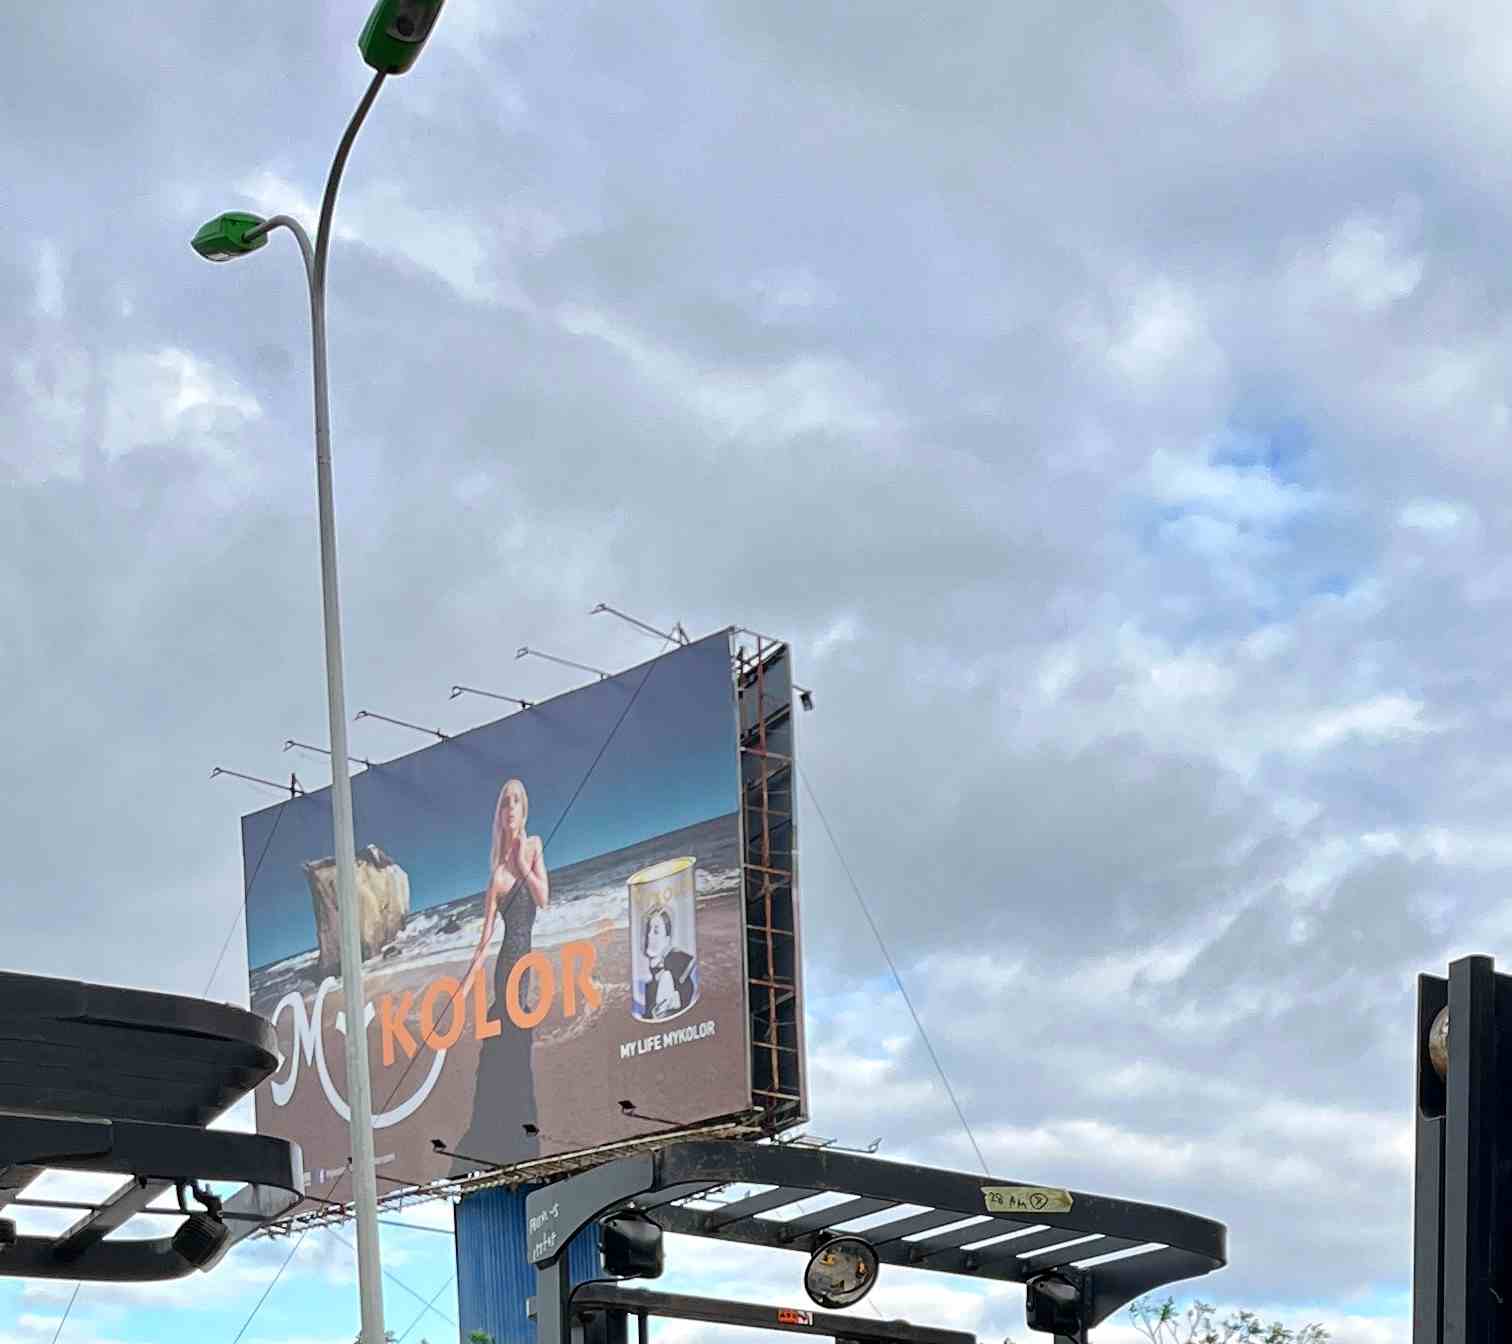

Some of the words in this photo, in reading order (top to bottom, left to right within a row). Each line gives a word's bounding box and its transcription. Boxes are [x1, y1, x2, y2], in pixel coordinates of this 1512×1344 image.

[620, 1041, 637, 1059] MY
[638, 1034, 661, 1055] LIFE
[663, 1020, 716, 1048] MYKOLOR
